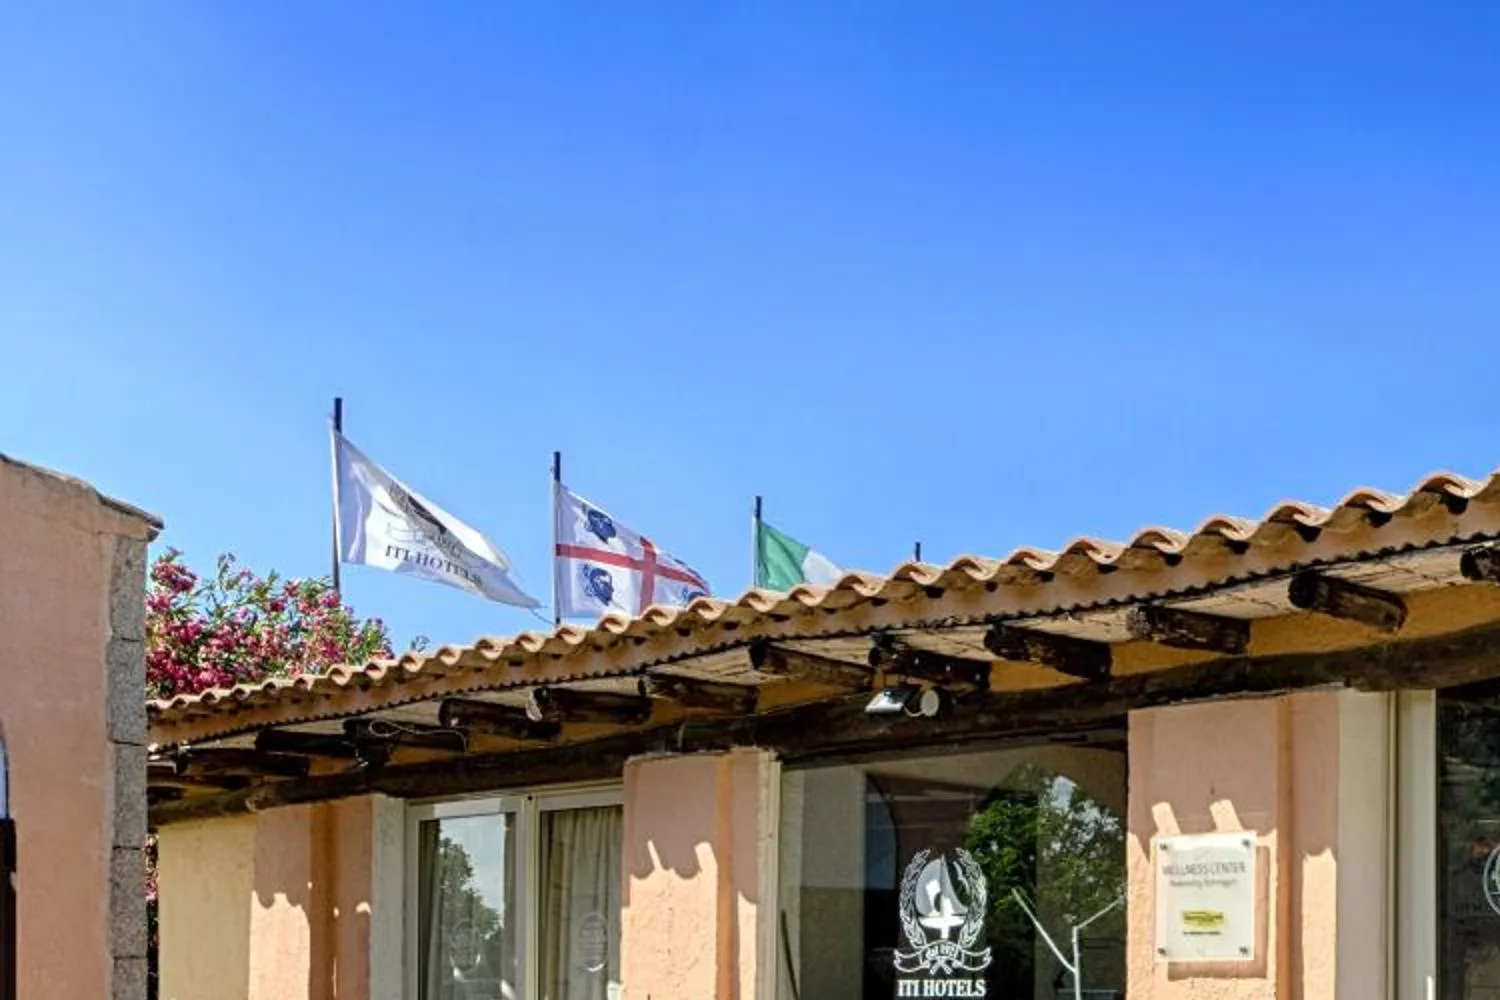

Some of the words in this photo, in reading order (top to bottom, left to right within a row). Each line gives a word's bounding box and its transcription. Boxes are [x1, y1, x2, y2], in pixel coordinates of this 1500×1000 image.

[1208, 861, 1248, 875] CENTER
[897, 979, 920, 998] ITI
[923, 979, 987, 998] HOTELS
